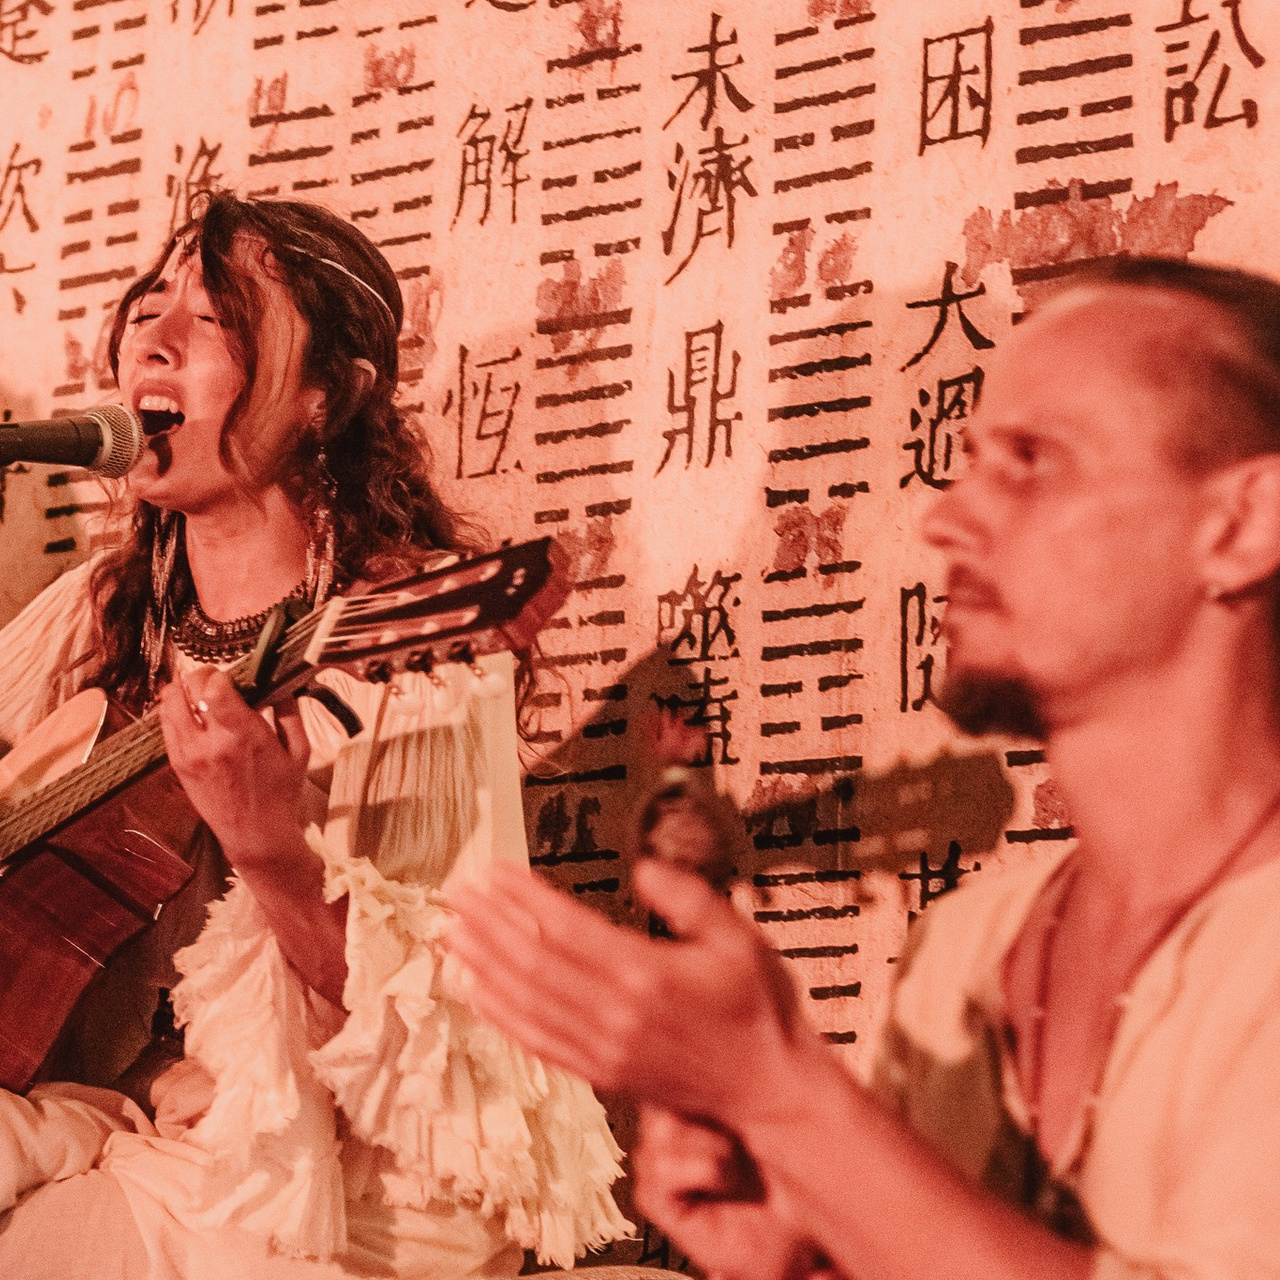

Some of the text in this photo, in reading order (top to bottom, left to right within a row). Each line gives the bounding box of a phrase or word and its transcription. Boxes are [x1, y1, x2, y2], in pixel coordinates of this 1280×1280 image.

[917, 15, 995, 158] 困
[450, 96, 535, 232] 解
[654, 318, 744, 480] 鼎
